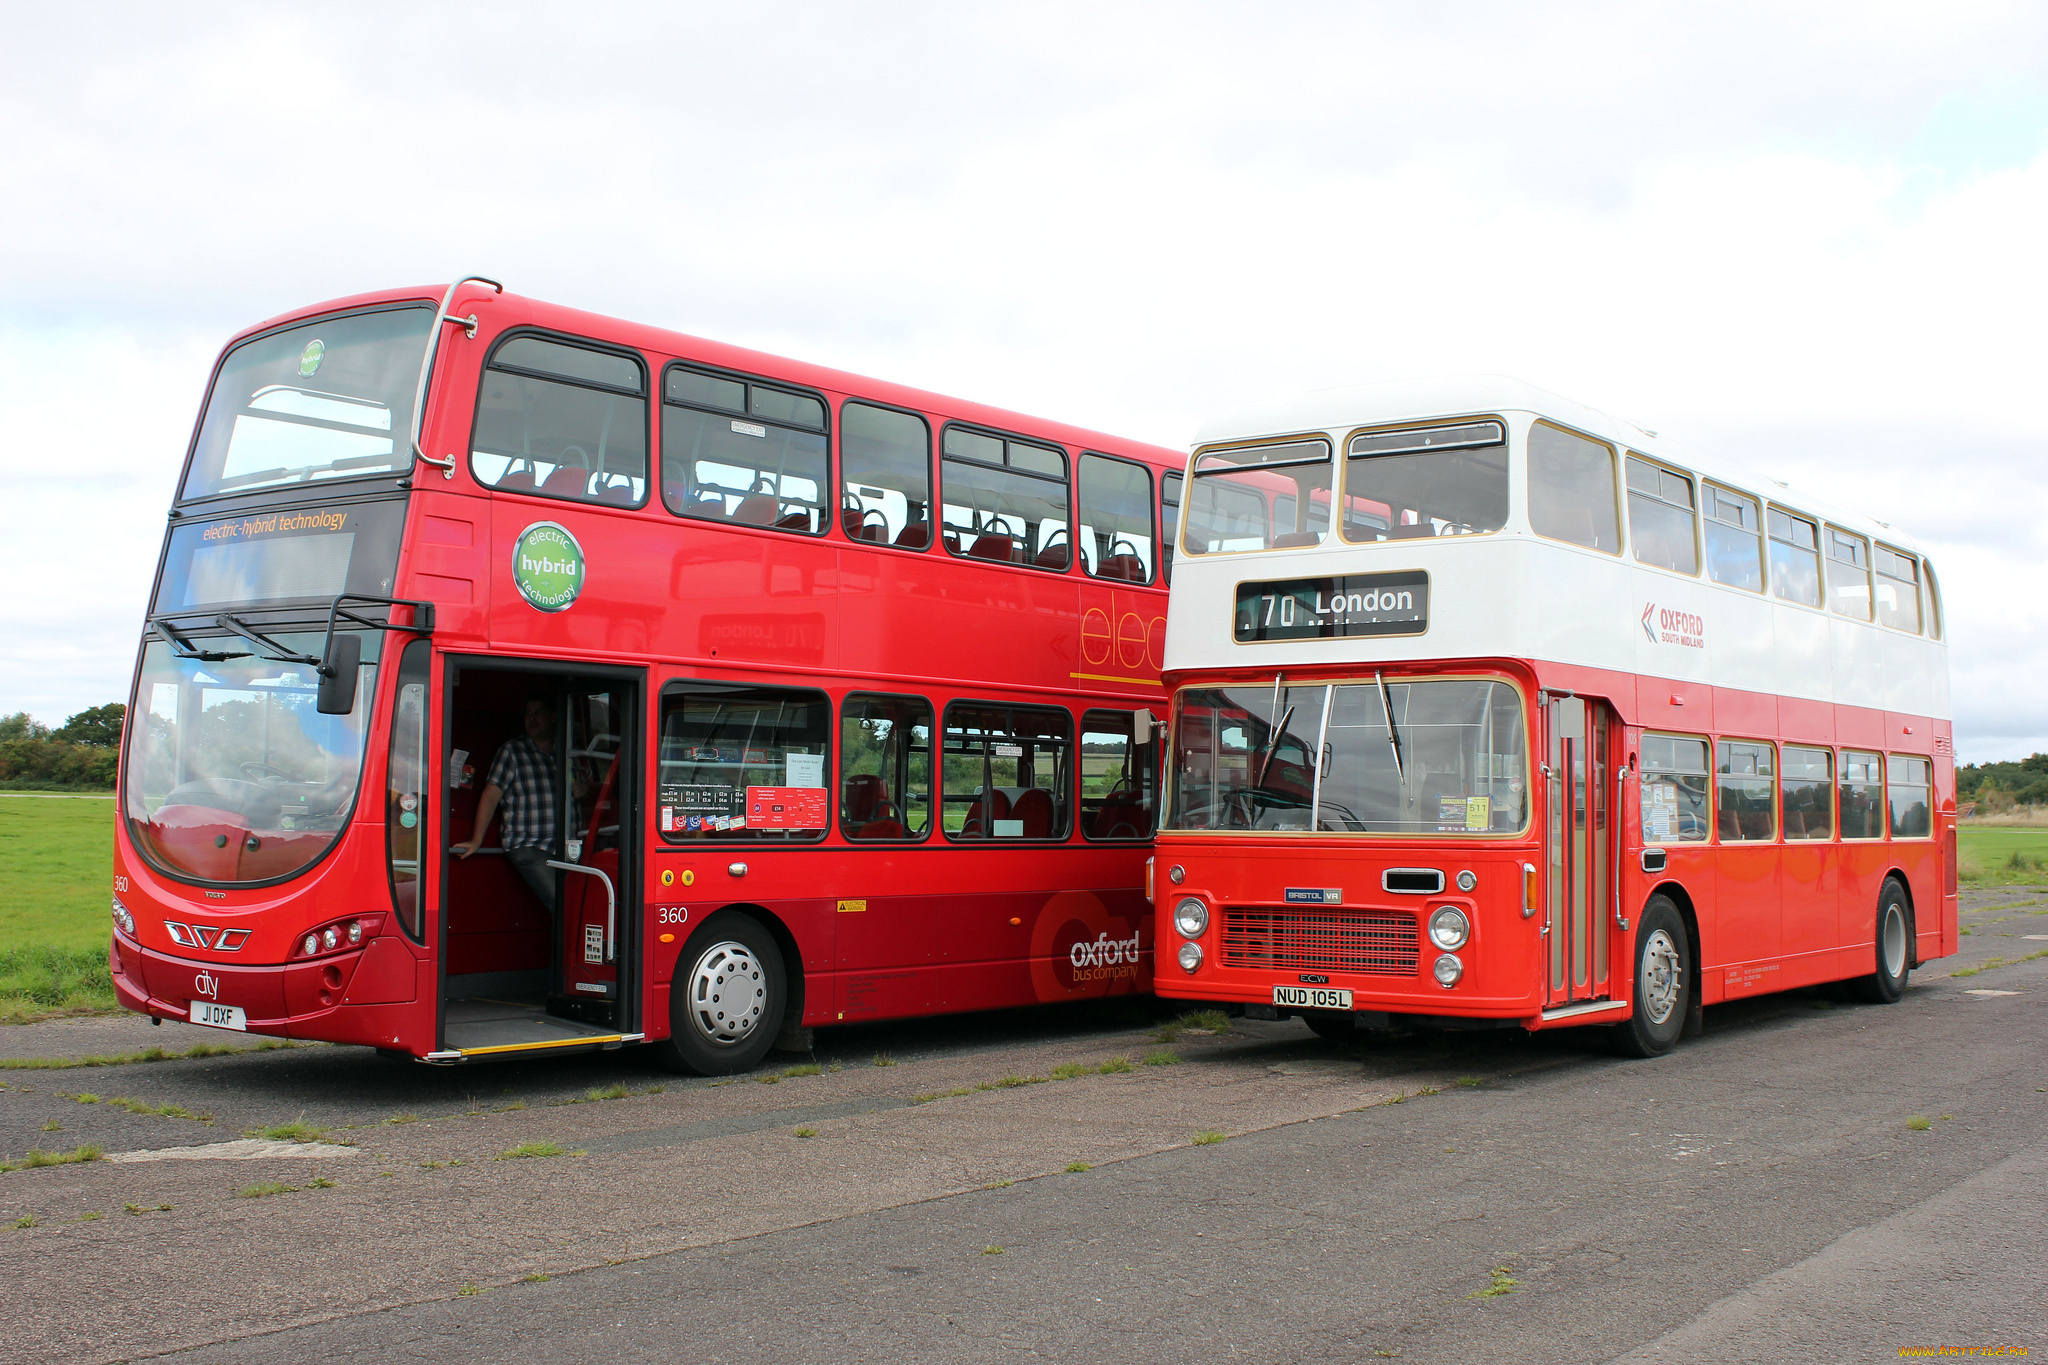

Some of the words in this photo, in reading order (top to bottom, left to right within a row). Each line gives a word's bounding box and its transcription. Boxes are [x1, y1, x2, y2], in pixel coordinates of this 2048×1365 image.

[203, 516, 277, 539] electric-hybrid
[279, 511, 348, 531] technology
[529, 531, 570, 549] electric
[522, 554, 576, 576] hybrid
[522, 580, 576, 605] technology
[1261, 595, 1295, 627] 70
[1316, 588, 1413, 614] London
[1660, 608, 1703, 637] OXFORD
[1661, 632, 1680, 645] SOUTH
[1680, 635, 1705, 649] MIDLAND
[1469, 804, 1486, 812] 511
[114, 875, 129, 893] 360
[1288, 892, 1322, 900] BRISTOL
[1326, 892, 1339, 900] VR
[659, 906, 688, 924] 360
[1070, 930, 1139, 968] oxford
[1073, 966, 1092, 981] bus
[1093, 965, 1139, 981] company
[1300, 974, 1326, 983] ECW
[195, 969, 219, 1000] city
[1277, 988, 1307, 1004] NUD
[1311, 990, 1348, 1007] 105L
[213, 1007, 233, 1025] OXF
